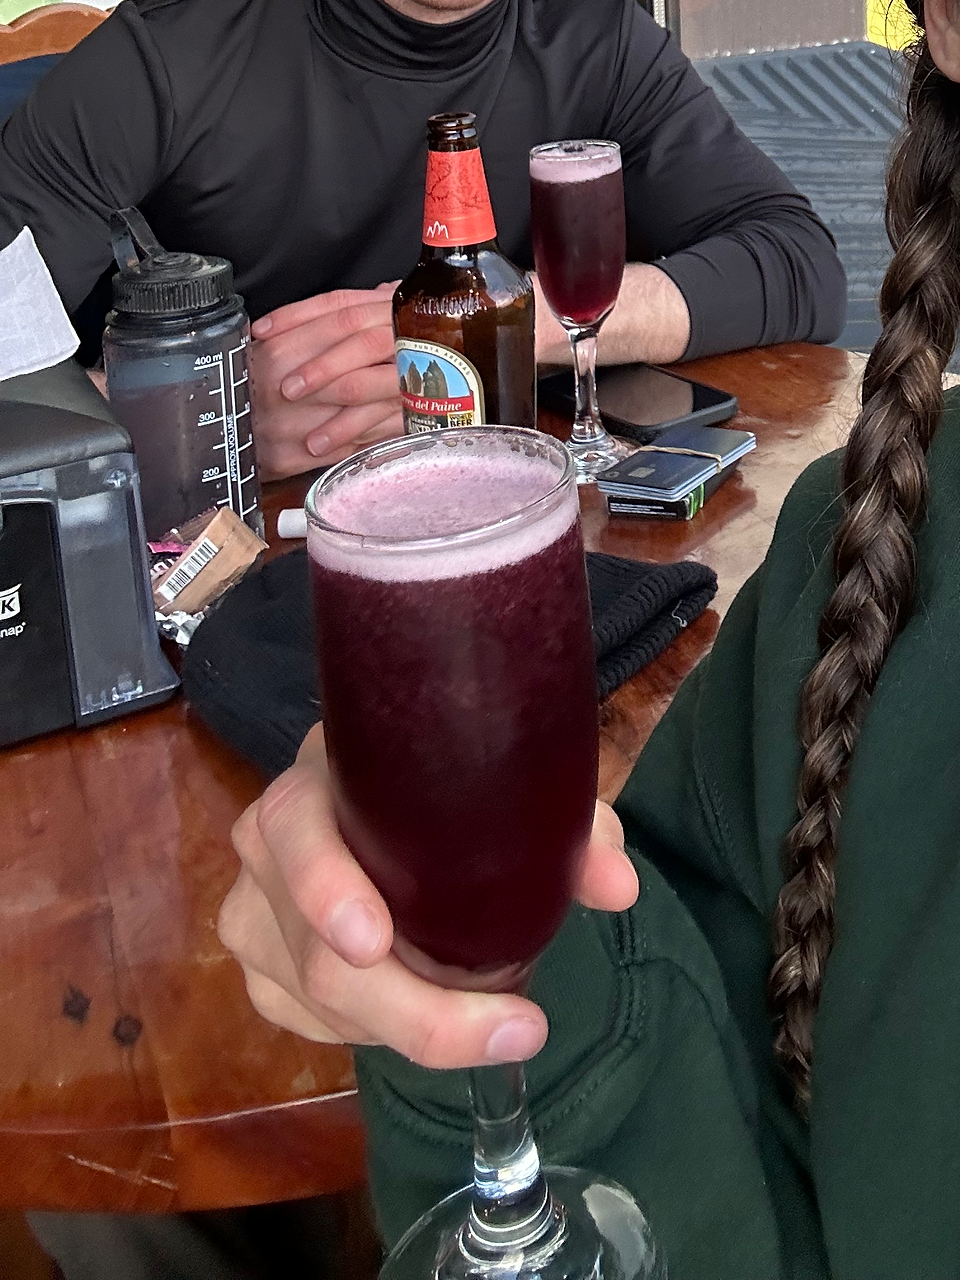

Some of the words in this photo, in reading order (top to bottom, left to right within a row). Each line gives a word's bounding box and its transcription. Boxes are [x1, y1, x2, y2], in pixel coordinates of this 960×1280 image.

[195, 355, 212, 365] 400
[213, 352, 223, 361] ml
[414, 344, 439, 353] PUNTA
[444, 352, 472, 376] ARENAS
[415, 400, 429, 410] del
[431, 401, 462, 411] Paine
[199, 412, 215, 422] 300
[450, 419, 473, 427] BEER
[227, 414, 235, 449] VOLUME
[229, 449, 238, 481] APPROX
[202, 467, 220, 478] 200
